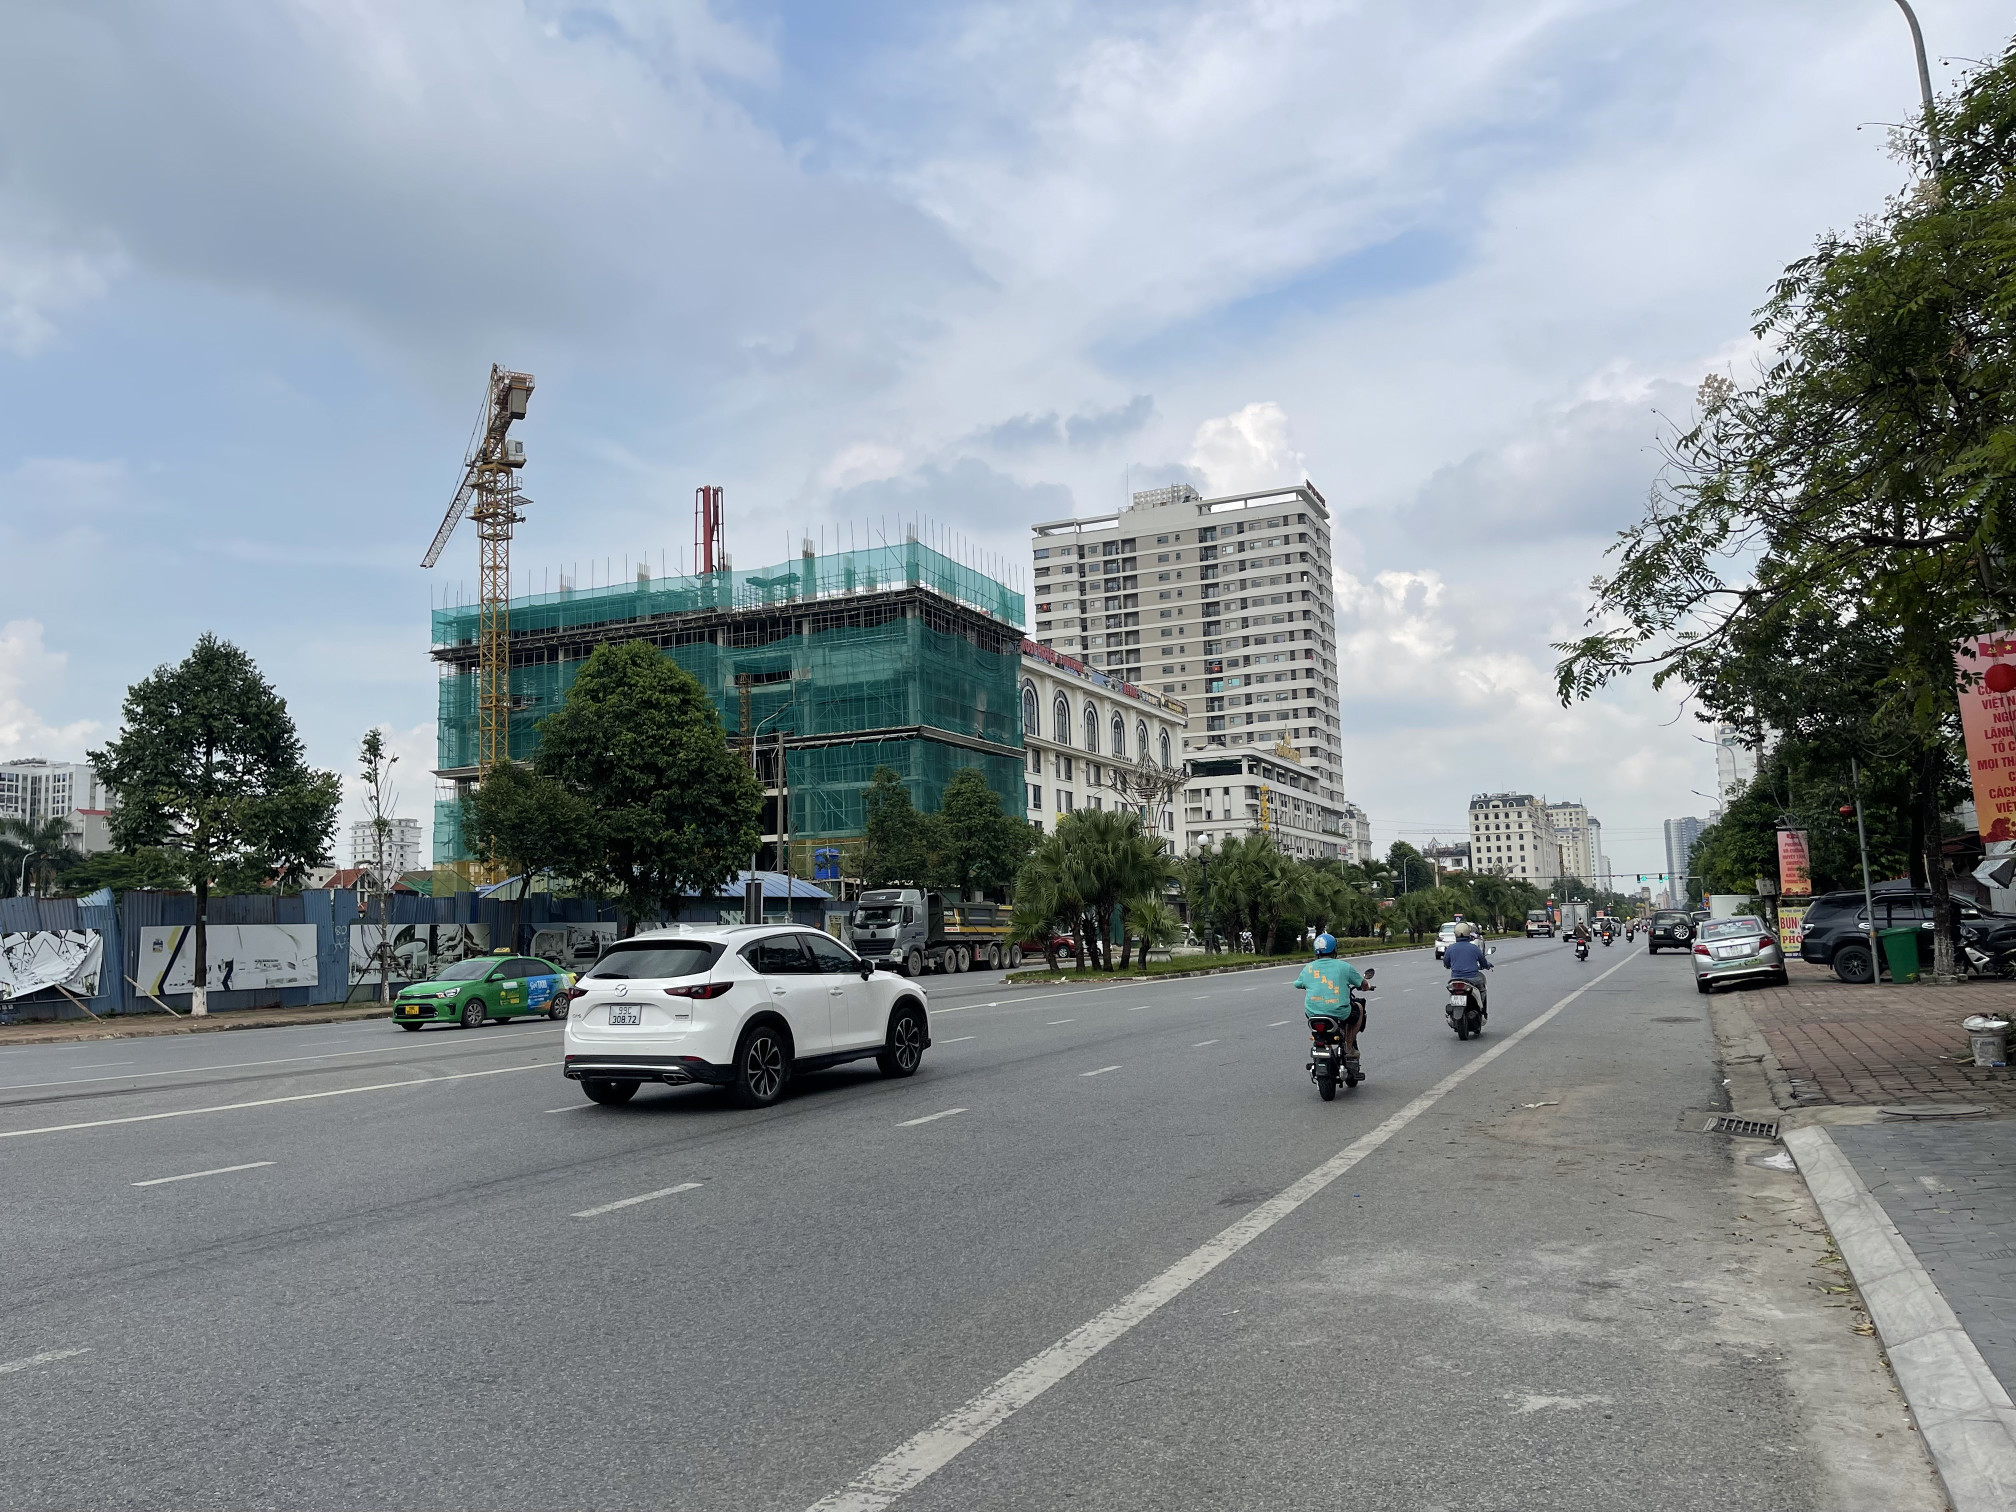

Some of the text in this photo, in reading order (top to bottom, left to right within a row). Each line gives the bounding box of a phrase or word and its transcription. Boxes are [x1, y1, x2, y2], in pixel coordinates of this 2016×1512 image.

[1981, 695, 2016, 711] VIỆT N
[1984, 726, 2014, 739] LÃNH
[1991, 738, 2016, 753] TỔ C
[1977, 755, 2016, 771] MỌI TH
[1988, 785, 2016, 799] CÁCH
[1780, 914, 1798, 929] BÚN
[618, 1006, 632, 1015] 99C
[612, 1015, 637, 1024] 308.72
